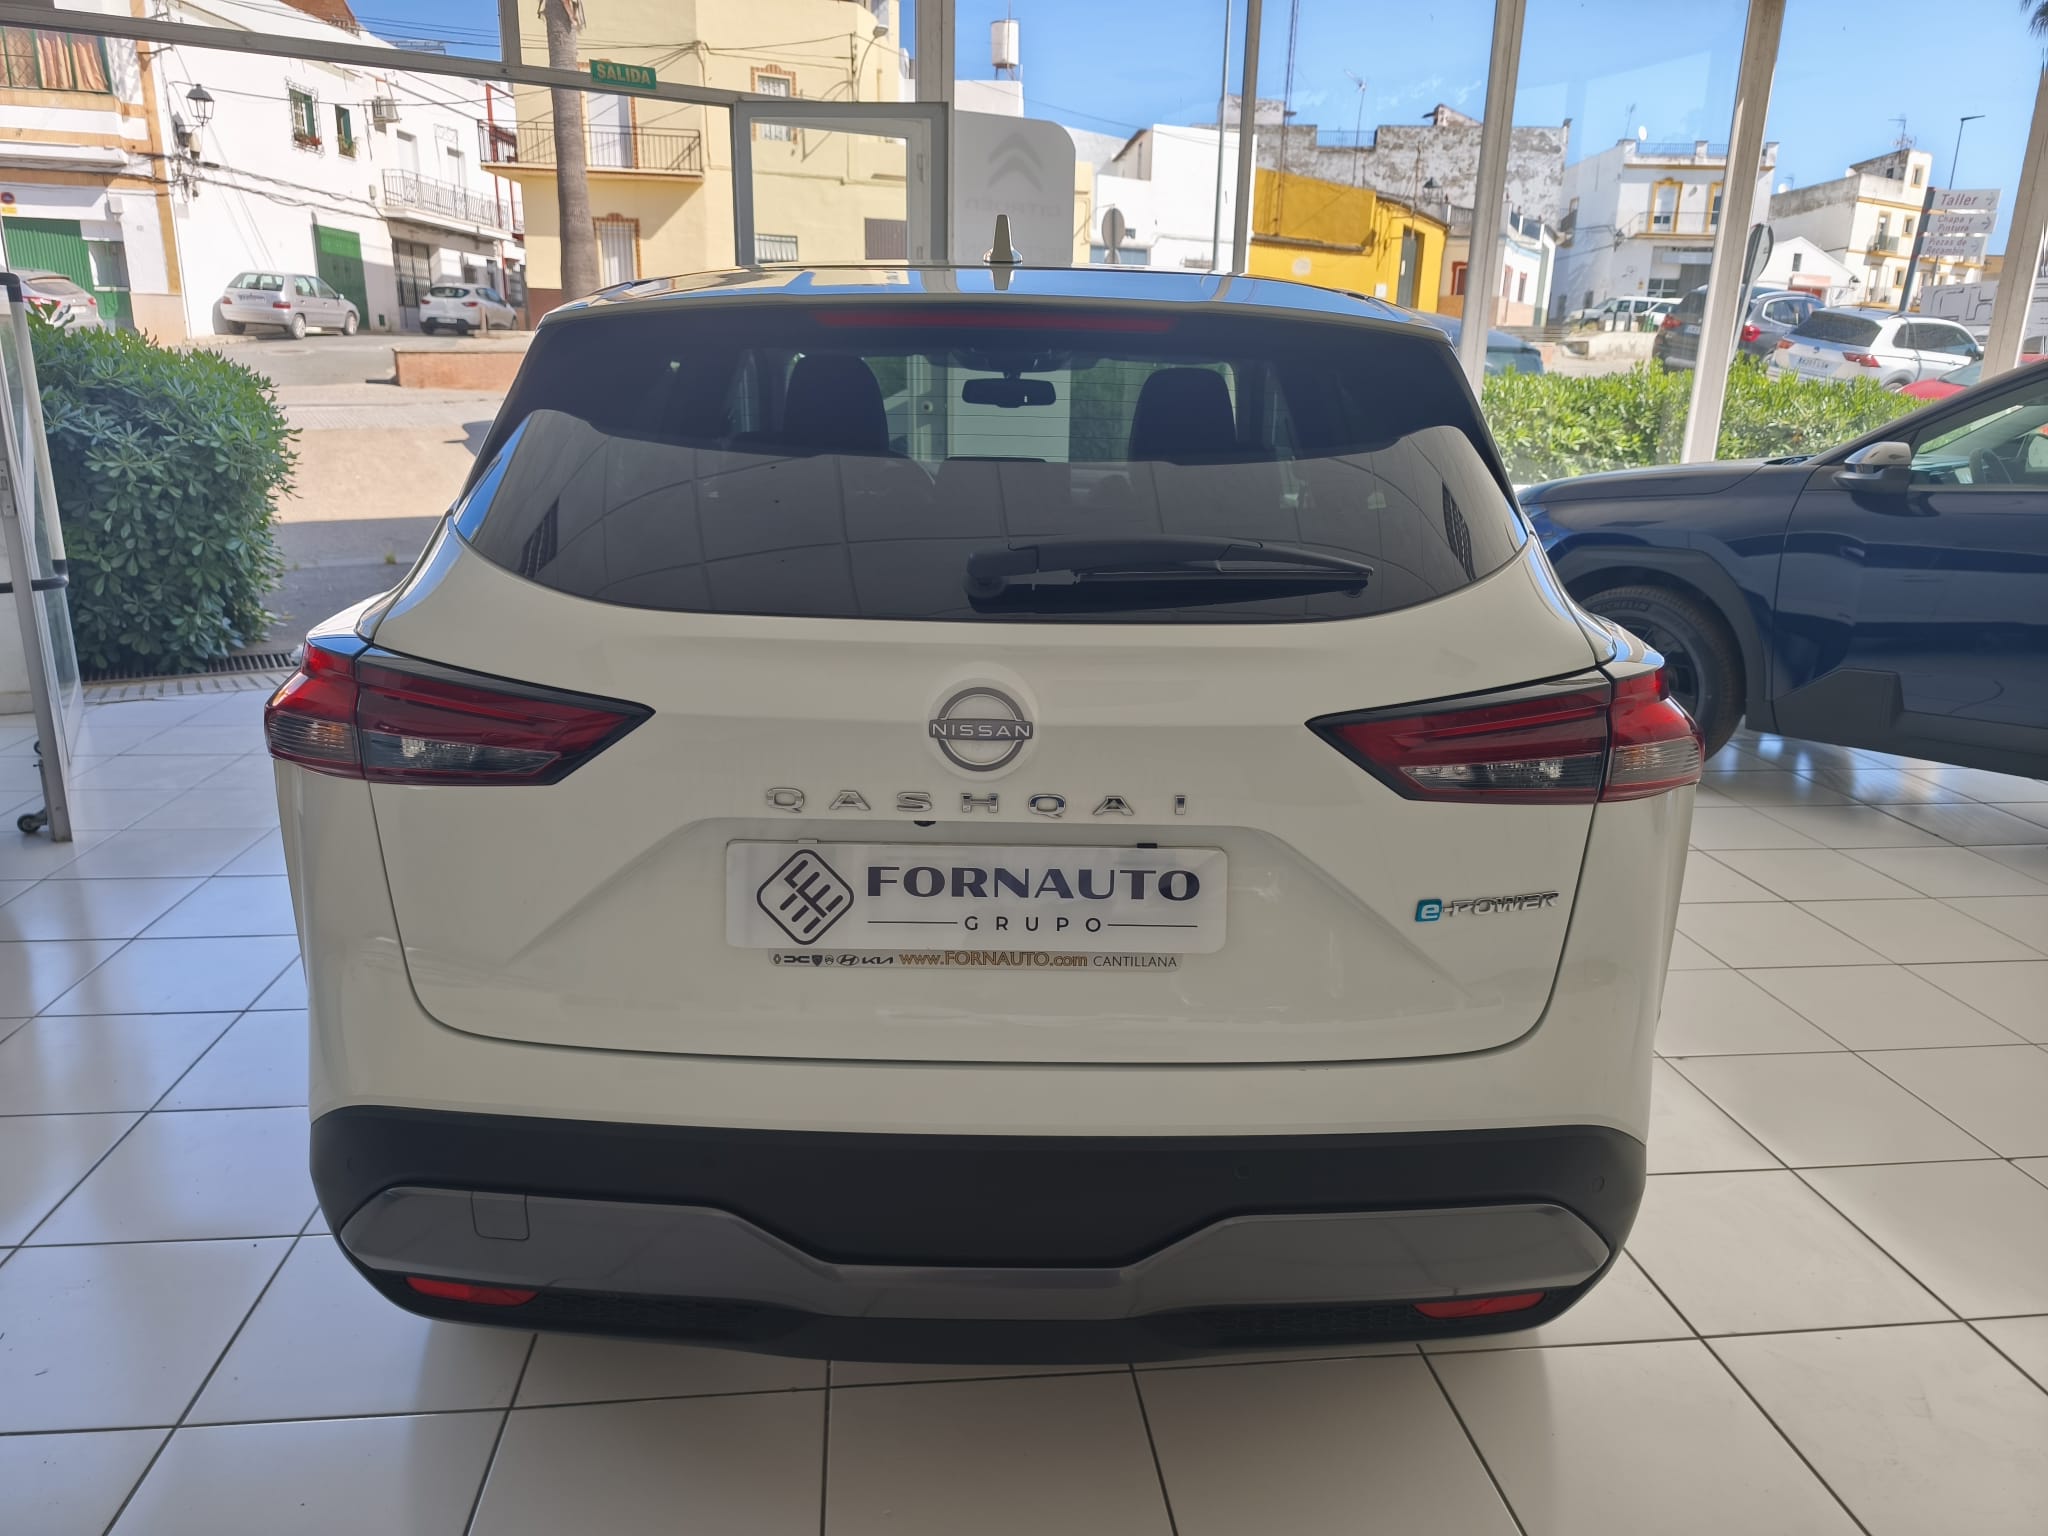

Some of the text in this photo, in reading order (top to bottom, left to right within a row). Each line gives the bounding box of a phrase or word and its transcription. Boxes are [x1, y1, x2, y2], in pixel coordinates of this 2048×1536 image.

[596, 63, 651, 84] SALIDA
[1941, 193, 1978, 206] Taller
[932, 723, 1030, 737] NISSAN
[766, 787, 1188, 818] QASHQAI
[867, 866, 1200, 901] FORNAUTO
[964, 915, 1101, 933] GRUPO
[899, 950, 1088, 967] www.FORNAUTO.com
[1093, 956, 1177, 968] CANTILLANA
